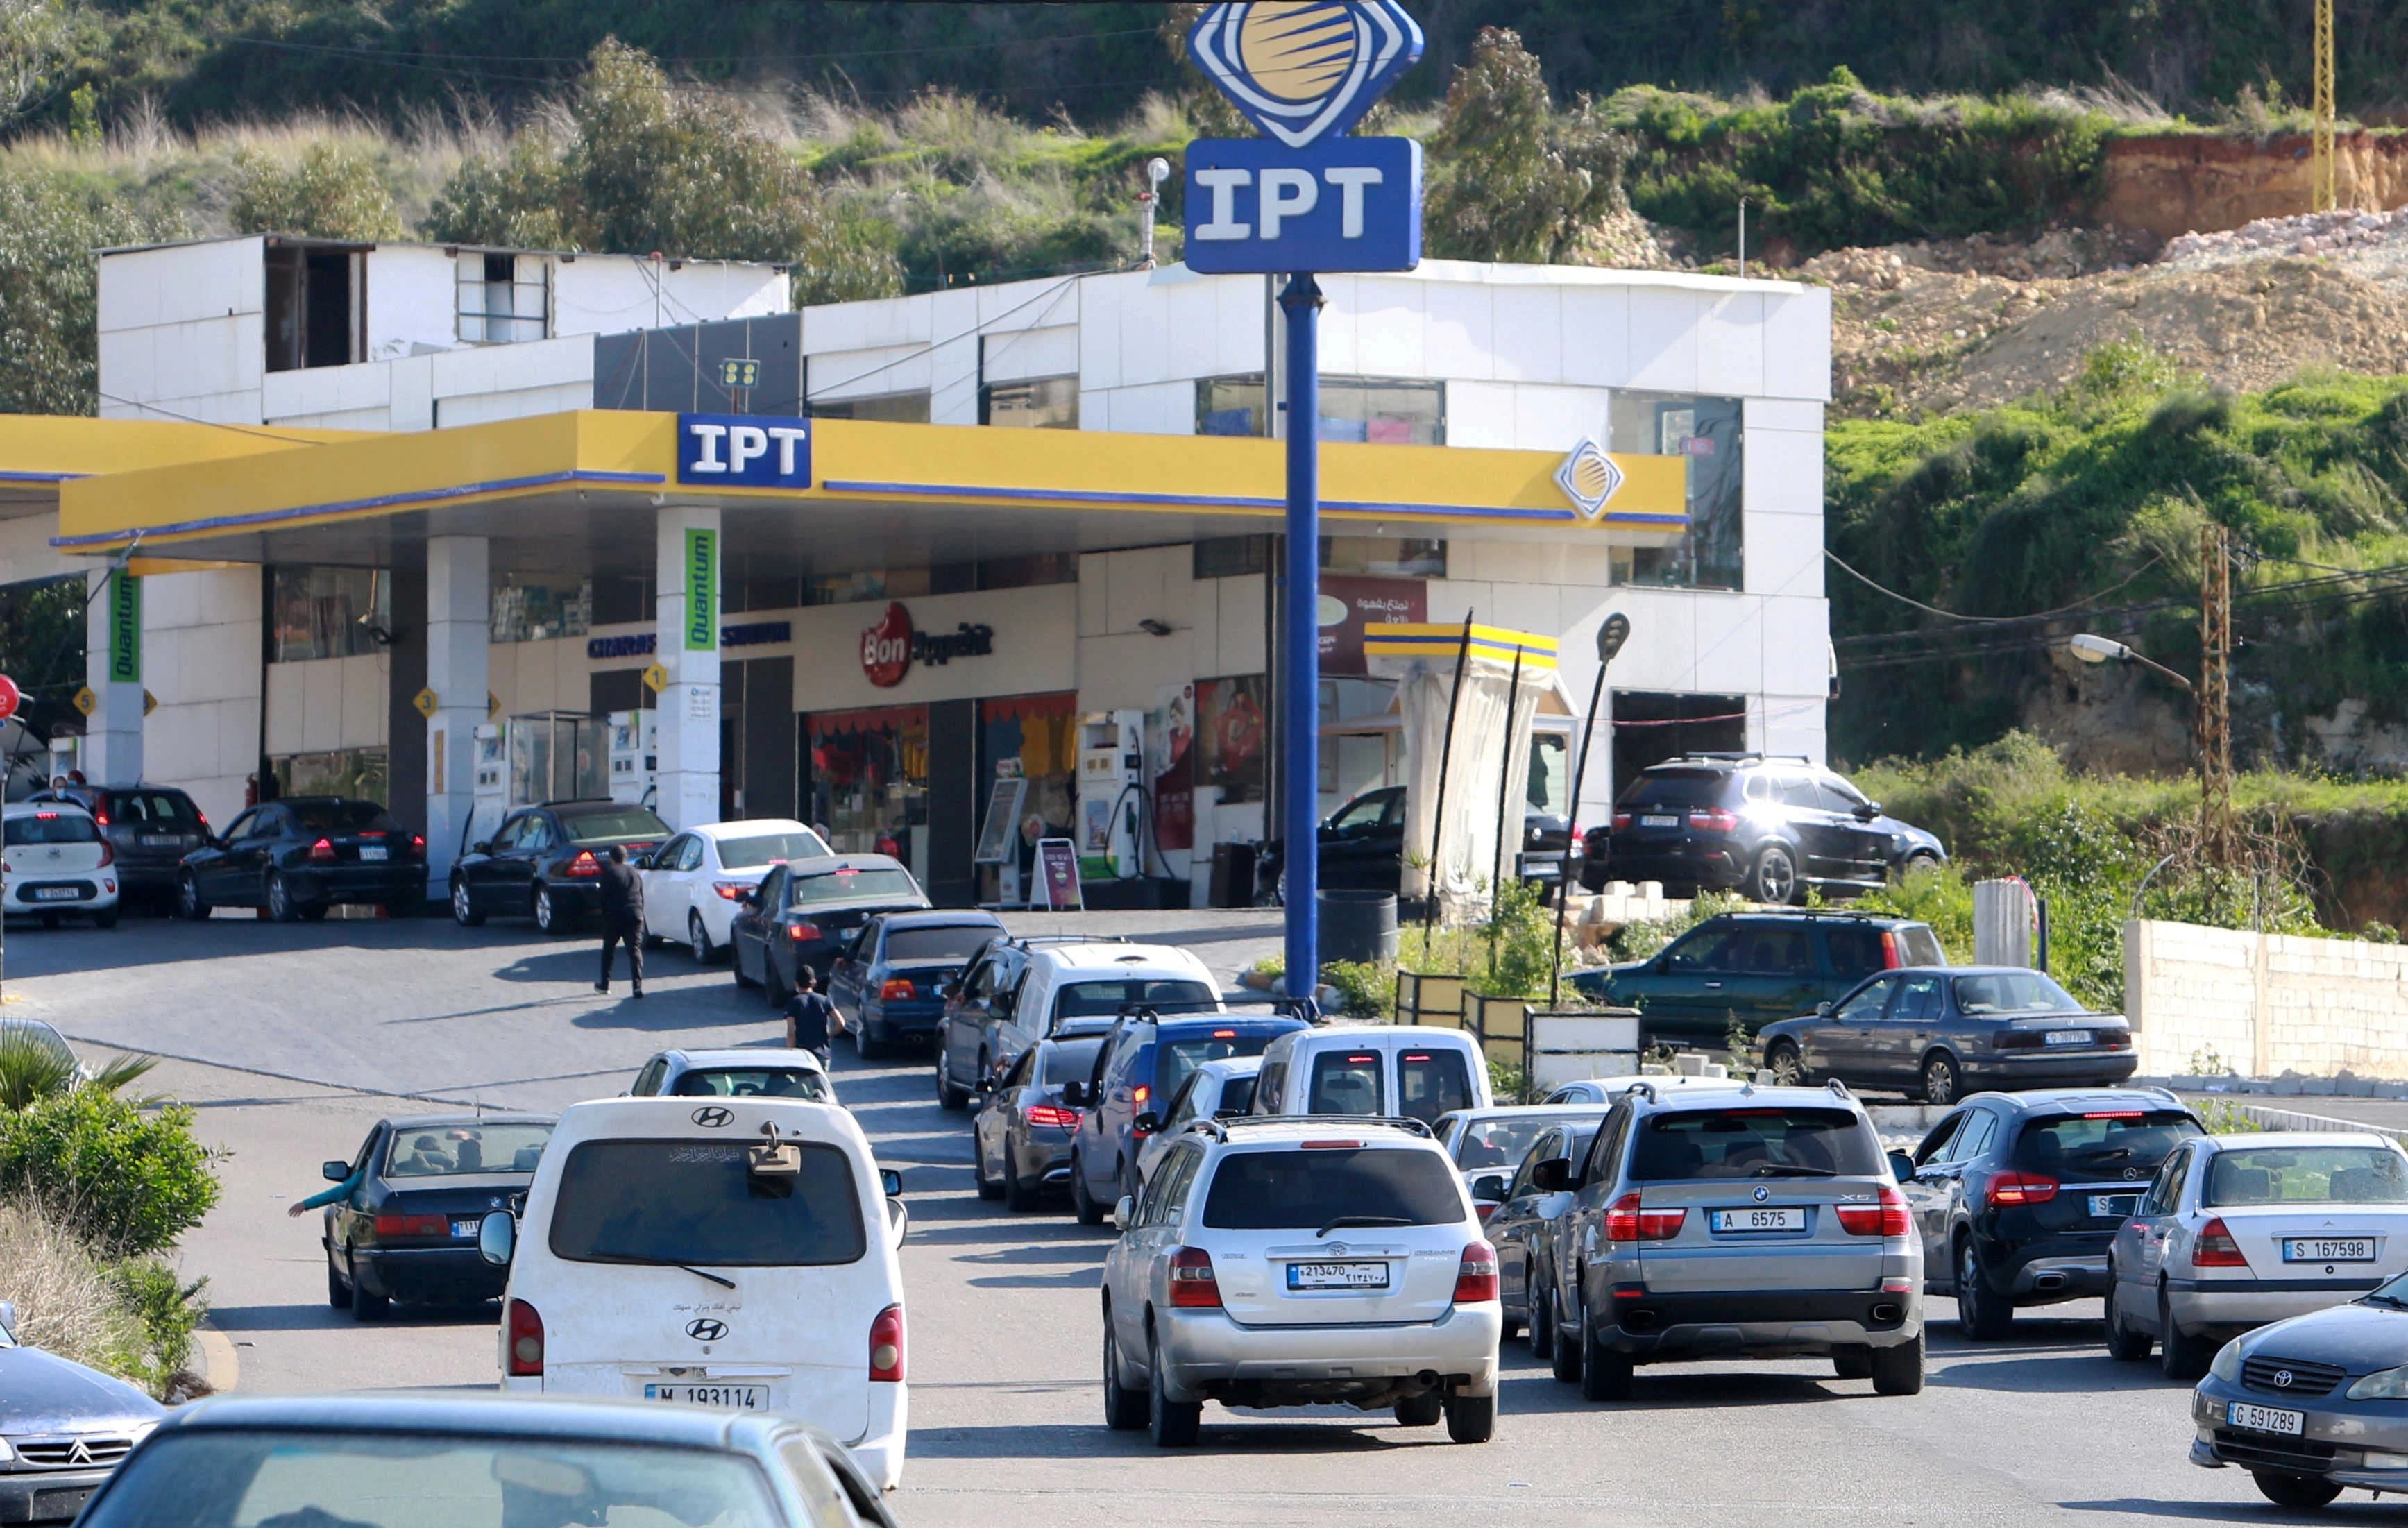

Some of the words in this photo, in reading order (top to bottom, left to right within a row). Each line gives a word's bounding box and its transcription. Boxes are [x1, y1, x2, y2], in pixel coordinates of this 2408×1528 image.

[1194, 167, 1384, 241] IPT
[690, 424, 806, 476] IPT
[691, 535, 709, 644] Quantum
[116, 577, 133, 677] Quantum
[864, 633, 906, 665] Bon
[80, 694, 90, 708] 5
[421, 695, 431, 710] 3
[2099, 1197, 2108, 1211] S
[1724, 1213, 1733, 1228] A
[1751, 1211, 1786, 1228] 6575
[2296, 1242, 2305, 1257] S
[2314, 1241, 2365, 1257] 167598
[1306, 1266, 1346, 1277] 213470
[661, 1388, 673, 1400] M
[688, 1388, 756, 1409] 193114
[2237, 1406, 2244, 1423] G
[2250, 1407, 2295, 1432] 591289
